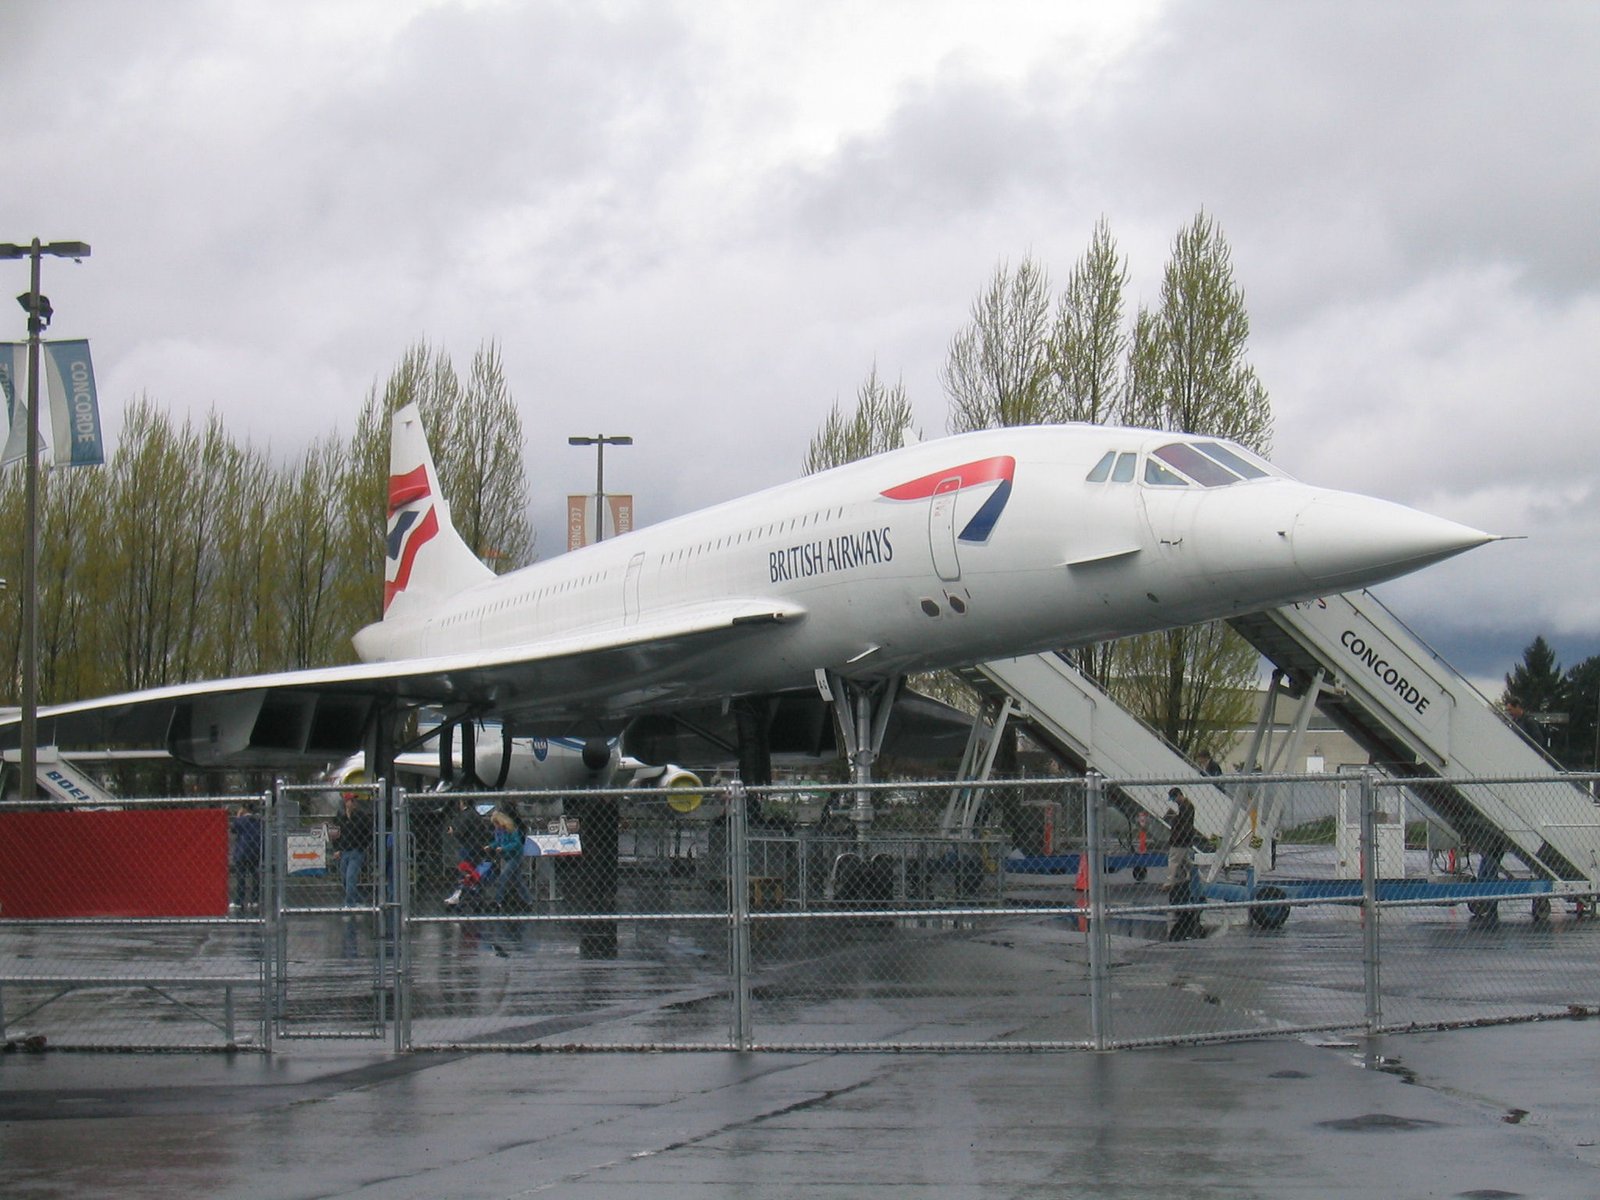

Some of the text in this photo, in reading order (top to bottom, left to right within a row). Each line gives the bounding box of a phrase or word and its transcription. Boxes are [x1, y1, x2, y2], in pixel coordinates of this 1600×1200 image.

[71, 361, 95, 442] CONCORDE
[571, 507, 582, 523] 737
[769, 526, 893, 583] BRITISH AIRWAYS
[1340, 630, 1430, 715] CONCORDE
[534, 741, 547, 749] NASA
